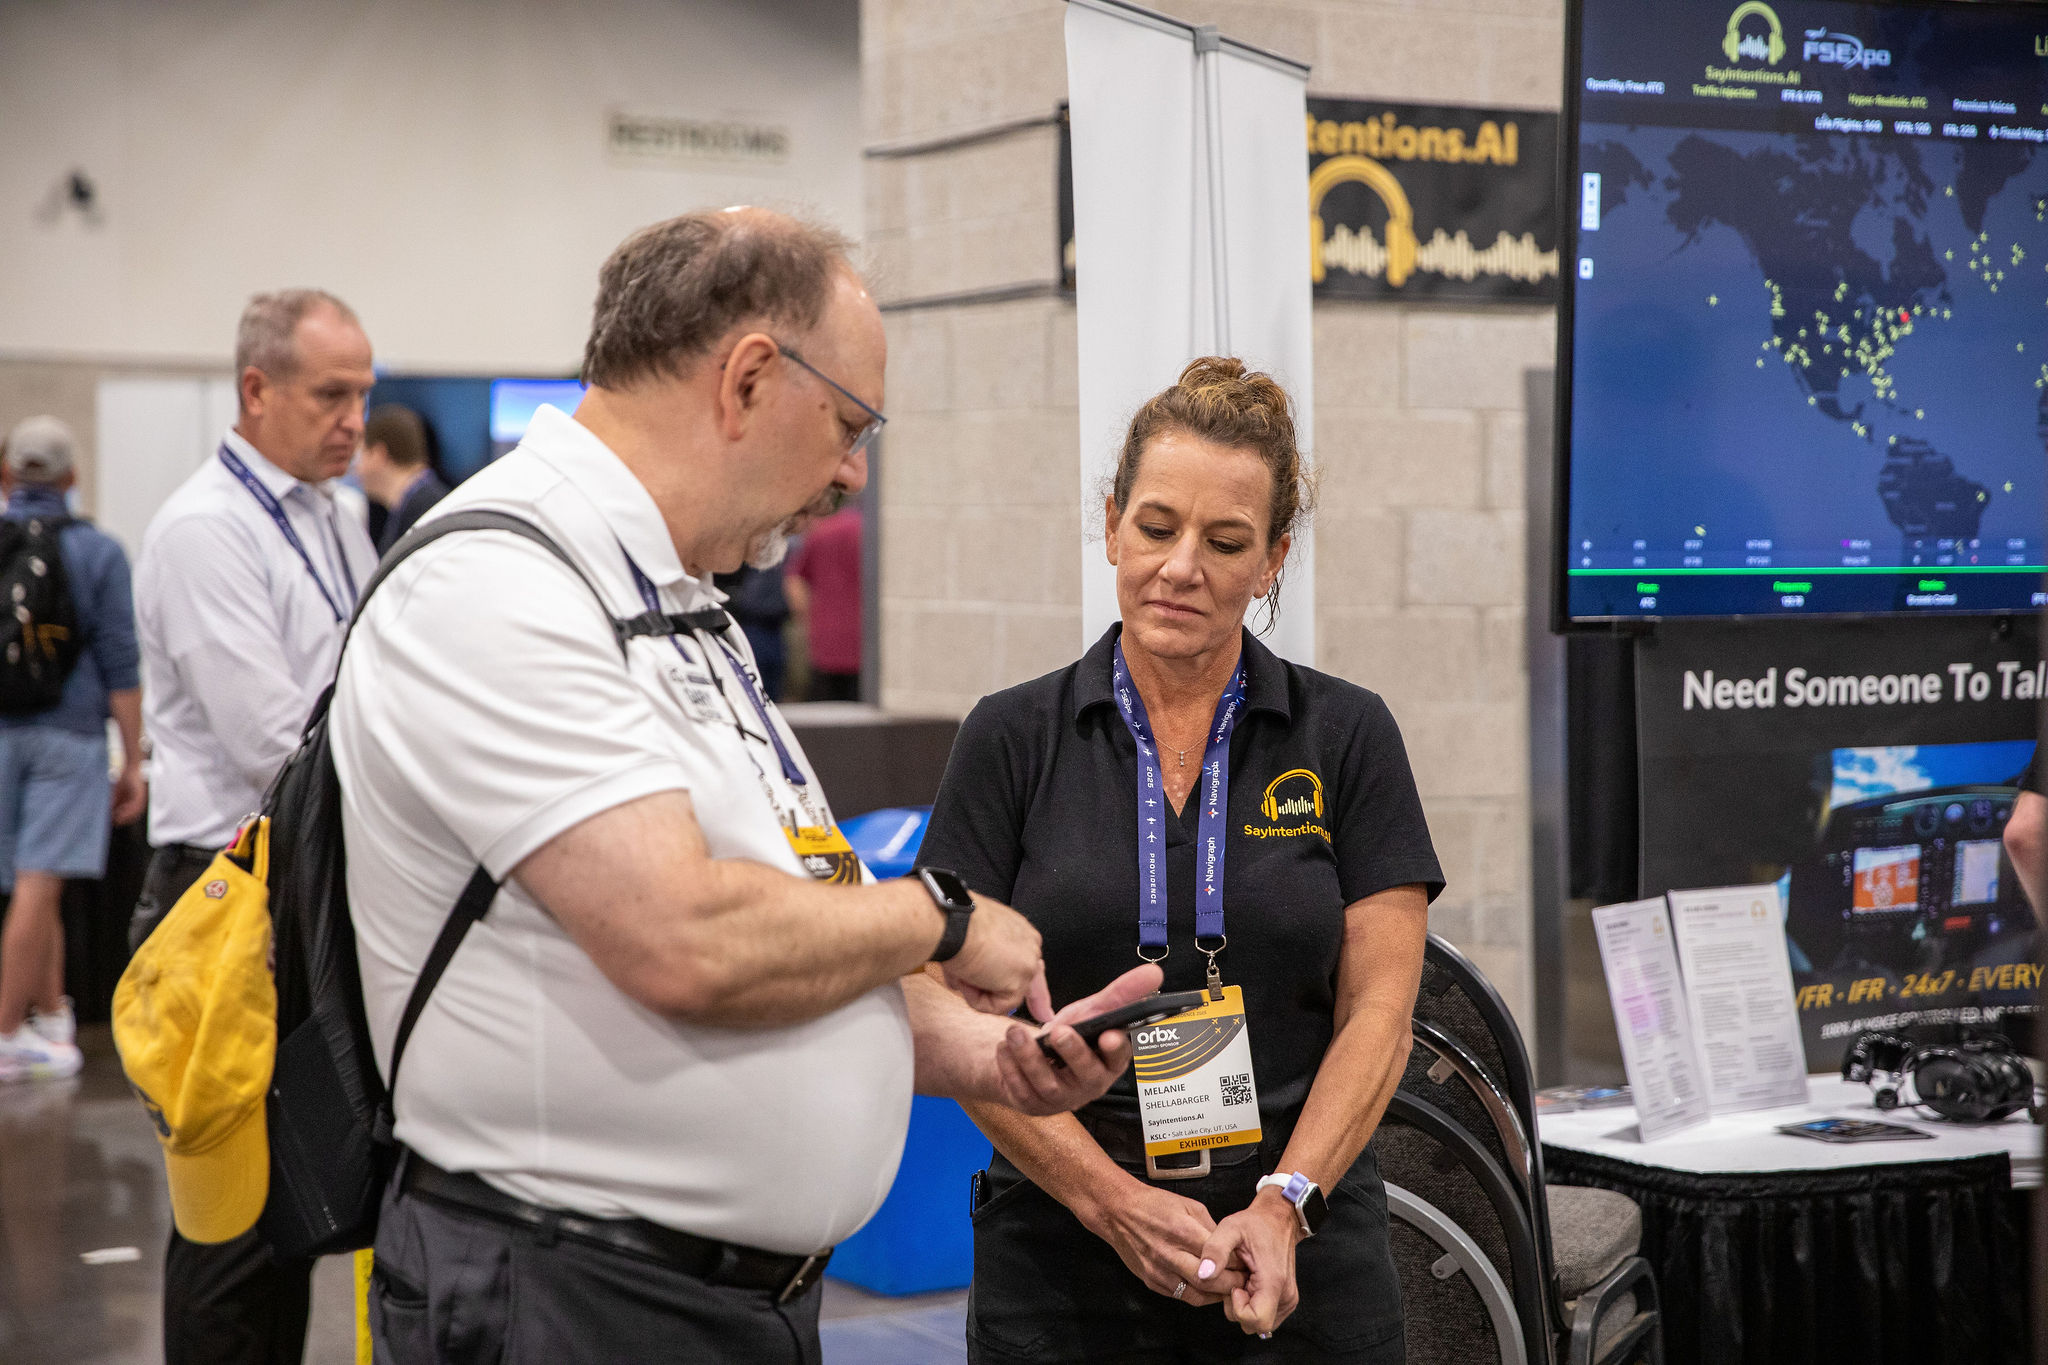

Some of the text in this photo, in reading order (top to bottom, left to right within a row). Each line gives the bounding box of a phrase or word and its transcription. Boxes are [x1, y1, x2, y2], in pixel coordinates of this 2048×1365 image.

[1683, 660, 2048, 710] Need Someone To Tal
[1146, 766, 1154, 788] 2025
[1209, 761, 1219, 806] Navigraph
[1206, 837, 1216, 882] Navigraph
[1149, 853, 1157, 905] PROVIDENCE
[1848, 977, 1887, 1005] IFR
[1900, 970, 1956, 999] 24x7
[1967, 963, 2046, 993] EVERY
[1137, 1027, 1179, 1044] orbx
[1144, 1083, 1186, 1096] MELANIE
[1145, 1094, 1210, 1110] SHELLABARGER
[1148, 1113, 1205, 1127] SayIntentions.AI
[1150, 1131, 1167, 1141] KSLC
[1171, 1130, 1183, 1138] Salt
[1184, 1127, 1199, 1136] Lake
[1225, 1123, 1238, 1131] USA
[1179, 1135, 1230, 1149] EXHIBITOR
